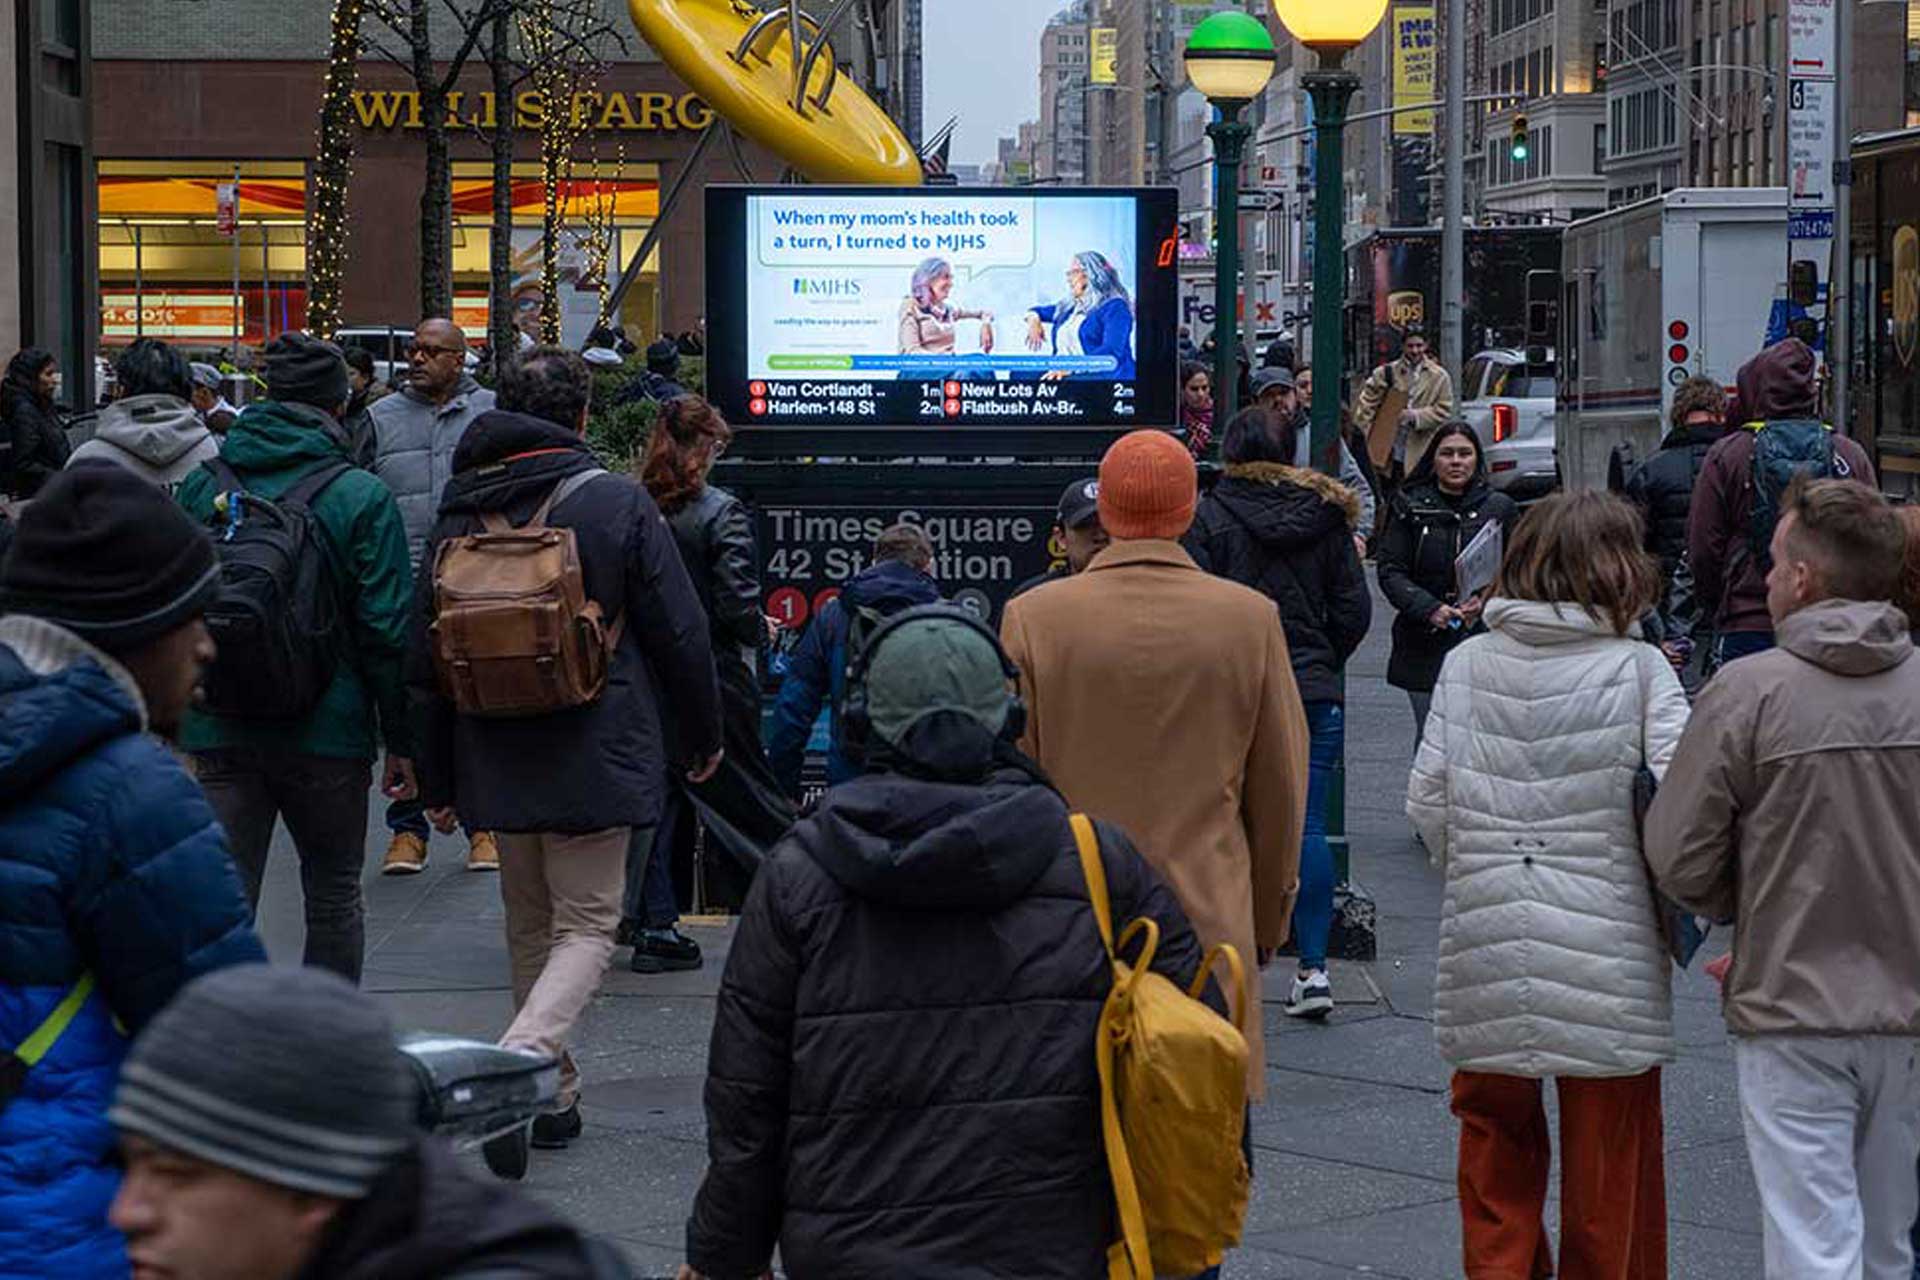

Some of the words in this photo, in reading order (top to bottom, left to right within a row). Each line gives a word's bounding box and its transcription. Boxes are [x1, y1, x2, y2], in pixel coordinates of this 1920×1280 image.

[1792, 82, 1802, 108] 6
[569, 91, 714, 130] FARG
[773, 209, 825, 226] When
[829, 213, 857, 230] my
[860, 210, 918, 226] mom's
[921, 209, 975, 226] health
[980, 210, 1019, 226] took
[773, 236, 784, 249] a
[789, 234, 833, 251] turn,
[836, 234, 842, 249] I
[846, 234, 906, 249] turned
[911, 234, 931, 249] to
[936, 234, 986, 252] MJHS
[809, 279, 861, 296] MJHS
[1183, 295, 1275, 324] Fex
[1391, 303, 1421, 326] ups
[768, 383, 797, 397] Van
[800, 382, 873, 397] Cortlandt
[920, 382, 941, 397] 1m
[962, 383, 996, 397] New
[999, 383, 1033, 397] Lots
[1036, 383, 1058, 397] Av
[1113, 383, 1135, 397] 2m
[768, 400, 855, 415] Harlem-148
[858, 400, 876, 415] St
[920, 400, 941, 414] 2m
[962, 400, 1029, 415] Flatbush
[1113, 400, 1135, 414] 4m
[767, 510, 884, 542] Times
[767, 549, 812, 580] 42
[824, 548, 865, 580] St
[929, 549, 1012, 580] tion
